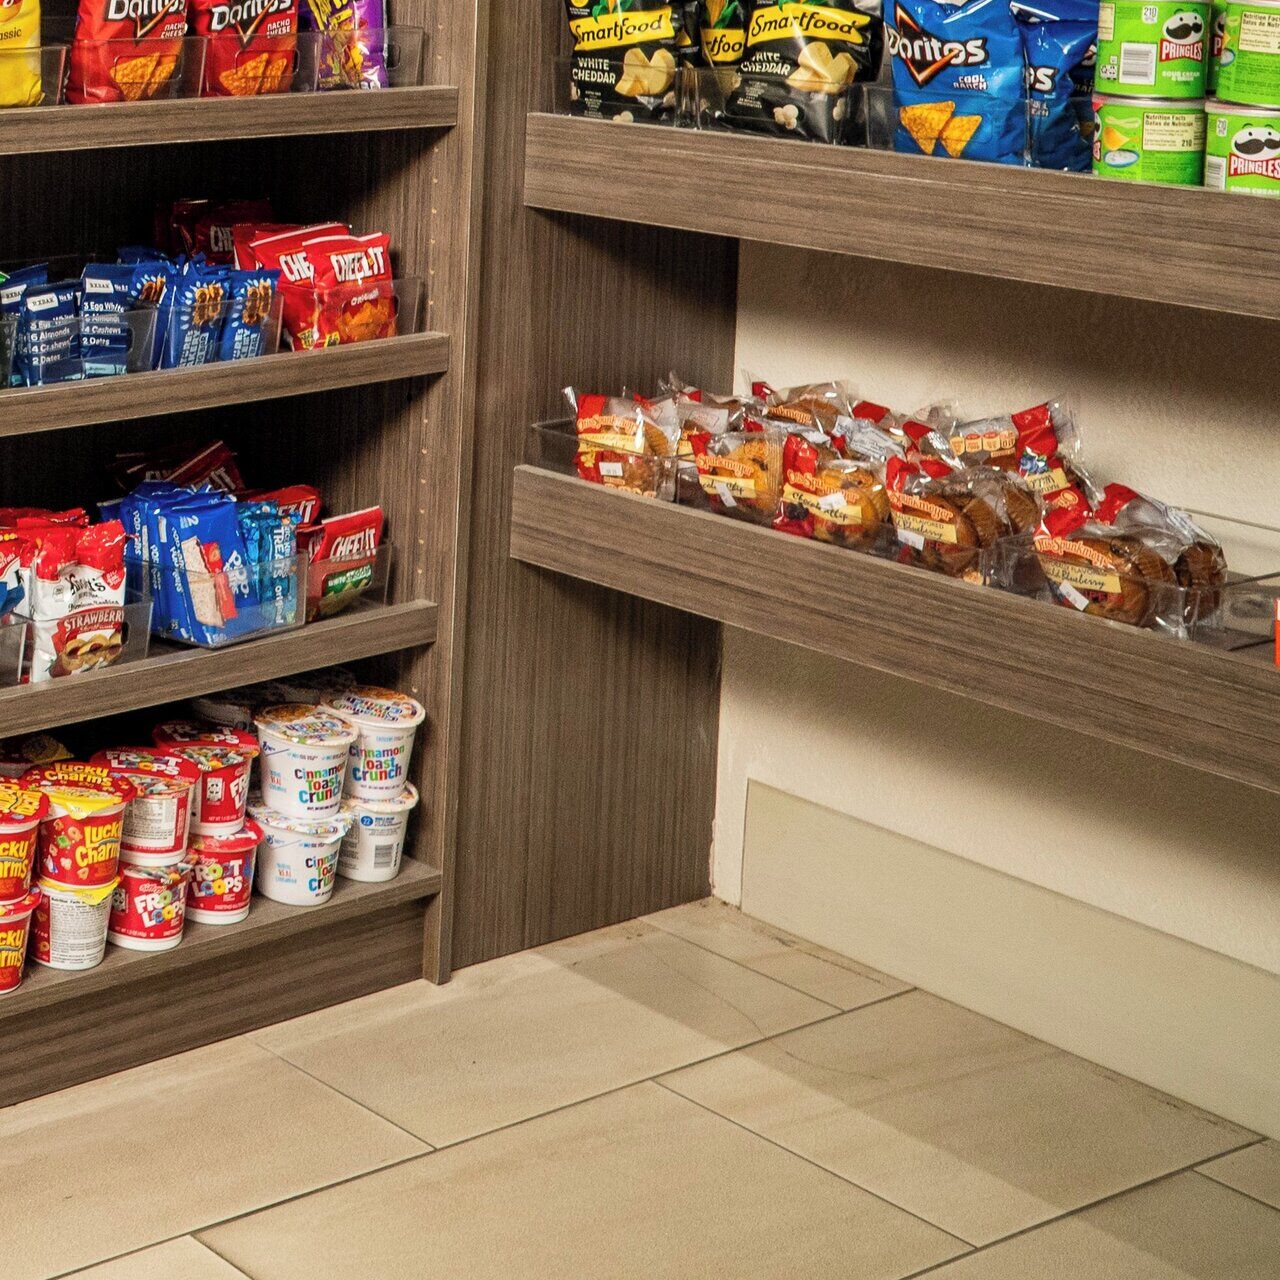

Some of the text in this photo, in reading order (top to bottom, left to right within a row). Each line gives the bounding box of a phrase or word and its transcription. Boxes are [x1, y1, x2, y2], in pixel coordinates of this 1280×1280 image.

[575, 14, 663, 42] Smartfood
[751, 12, 856, 40] Smartfood
[889, 28, 987, 64] Doritos
[1161, 39, 1203, 61] PRINGLES
[578, 57, 610, 71] WHITE
[741, 62, 791, 76] CHEDDAR
[572, 69, 616, 84] CHEDDAR
[39, 328, 70, 339] Almonds
[63, 611, 124, 631] STRAWBERRY
[349, 745, 405, 762] Cinnamon
[360, 757, 396, 771] Toast
[352, 766, 402, 782] Crunch
